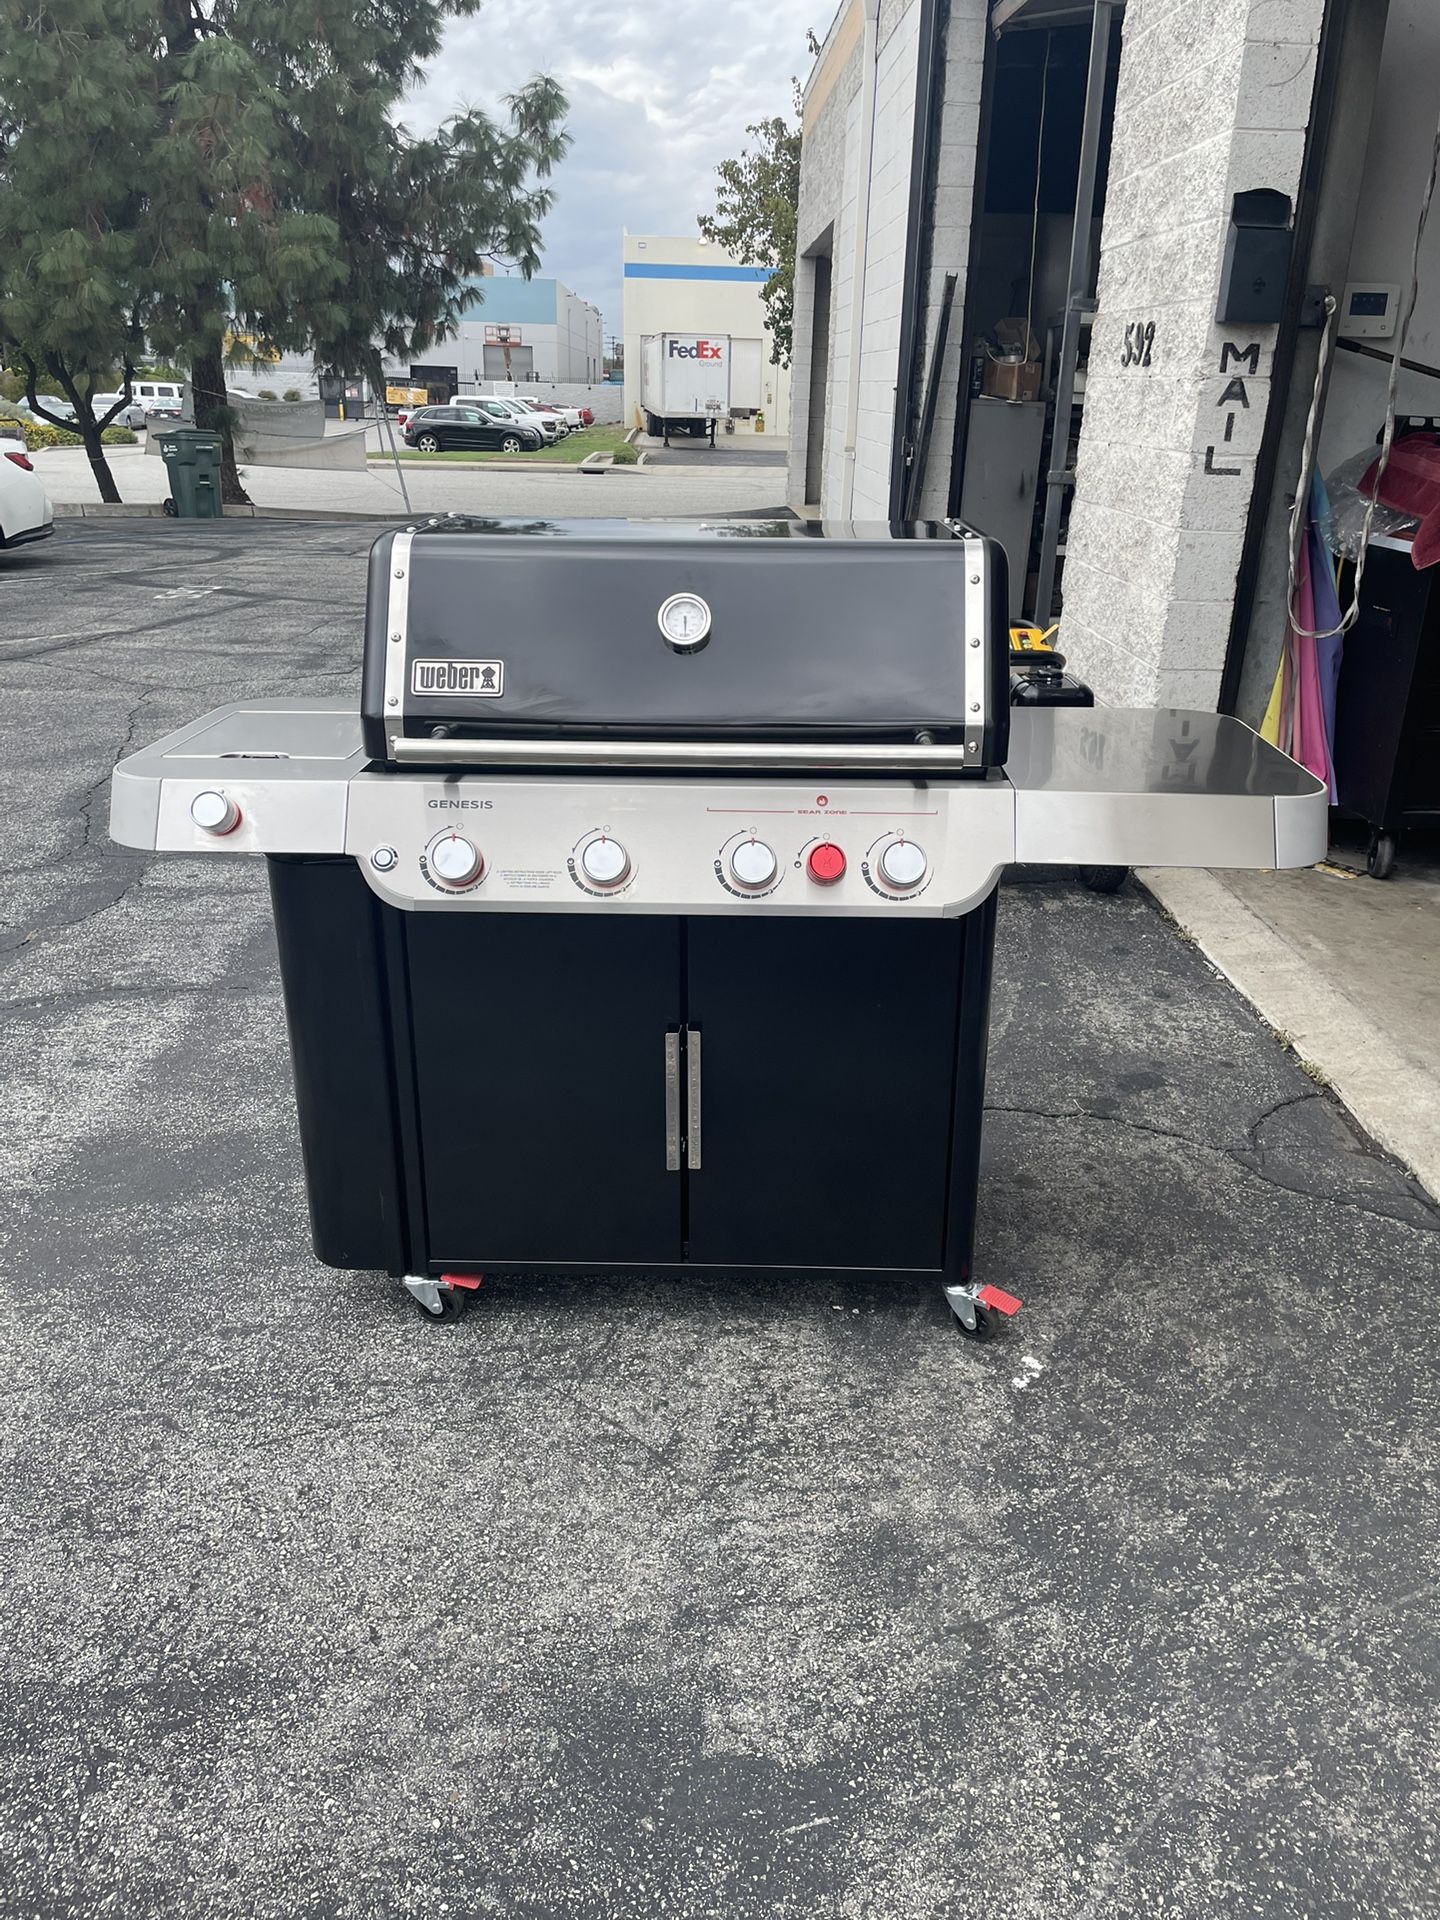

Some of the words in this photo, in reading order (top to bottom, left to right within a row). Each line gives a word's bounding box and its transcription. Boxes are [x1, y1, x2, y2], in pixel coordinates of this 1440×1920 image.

[669, 340, 722, 359] FedEx
[1121, 321, 1156, 368] 592
[699, 360, 723, 368] Ground
[1203, 342, 1261, 476] MAIL
[419, 662, 480, 689] weber
[428, 799, 493, 809] GENESIS
